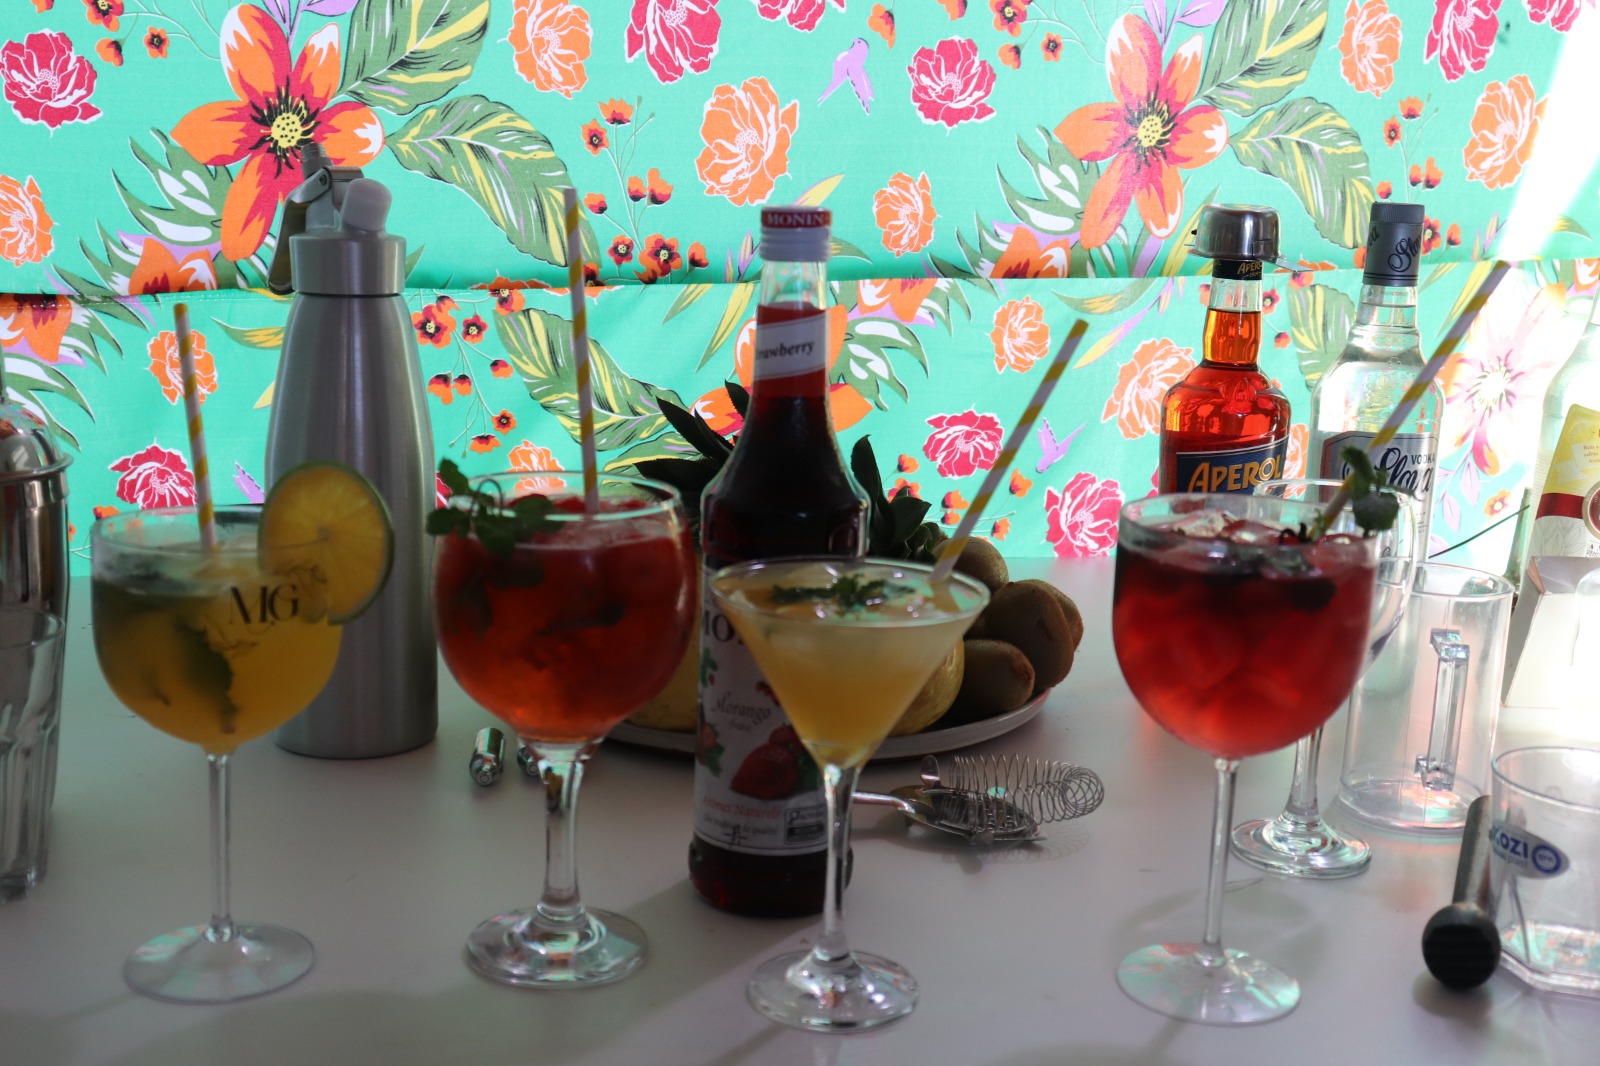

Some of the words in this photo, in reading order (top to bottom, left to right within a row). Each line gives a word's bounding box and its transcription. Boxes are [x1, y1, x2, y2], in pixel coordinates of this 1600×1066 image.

[767, 211, 825, 227] MONIN
[756, 341, 815, 359] rawberry
[1187, 455, 1282, 494] APEROL
[711, 692, 772, 726] Morango
